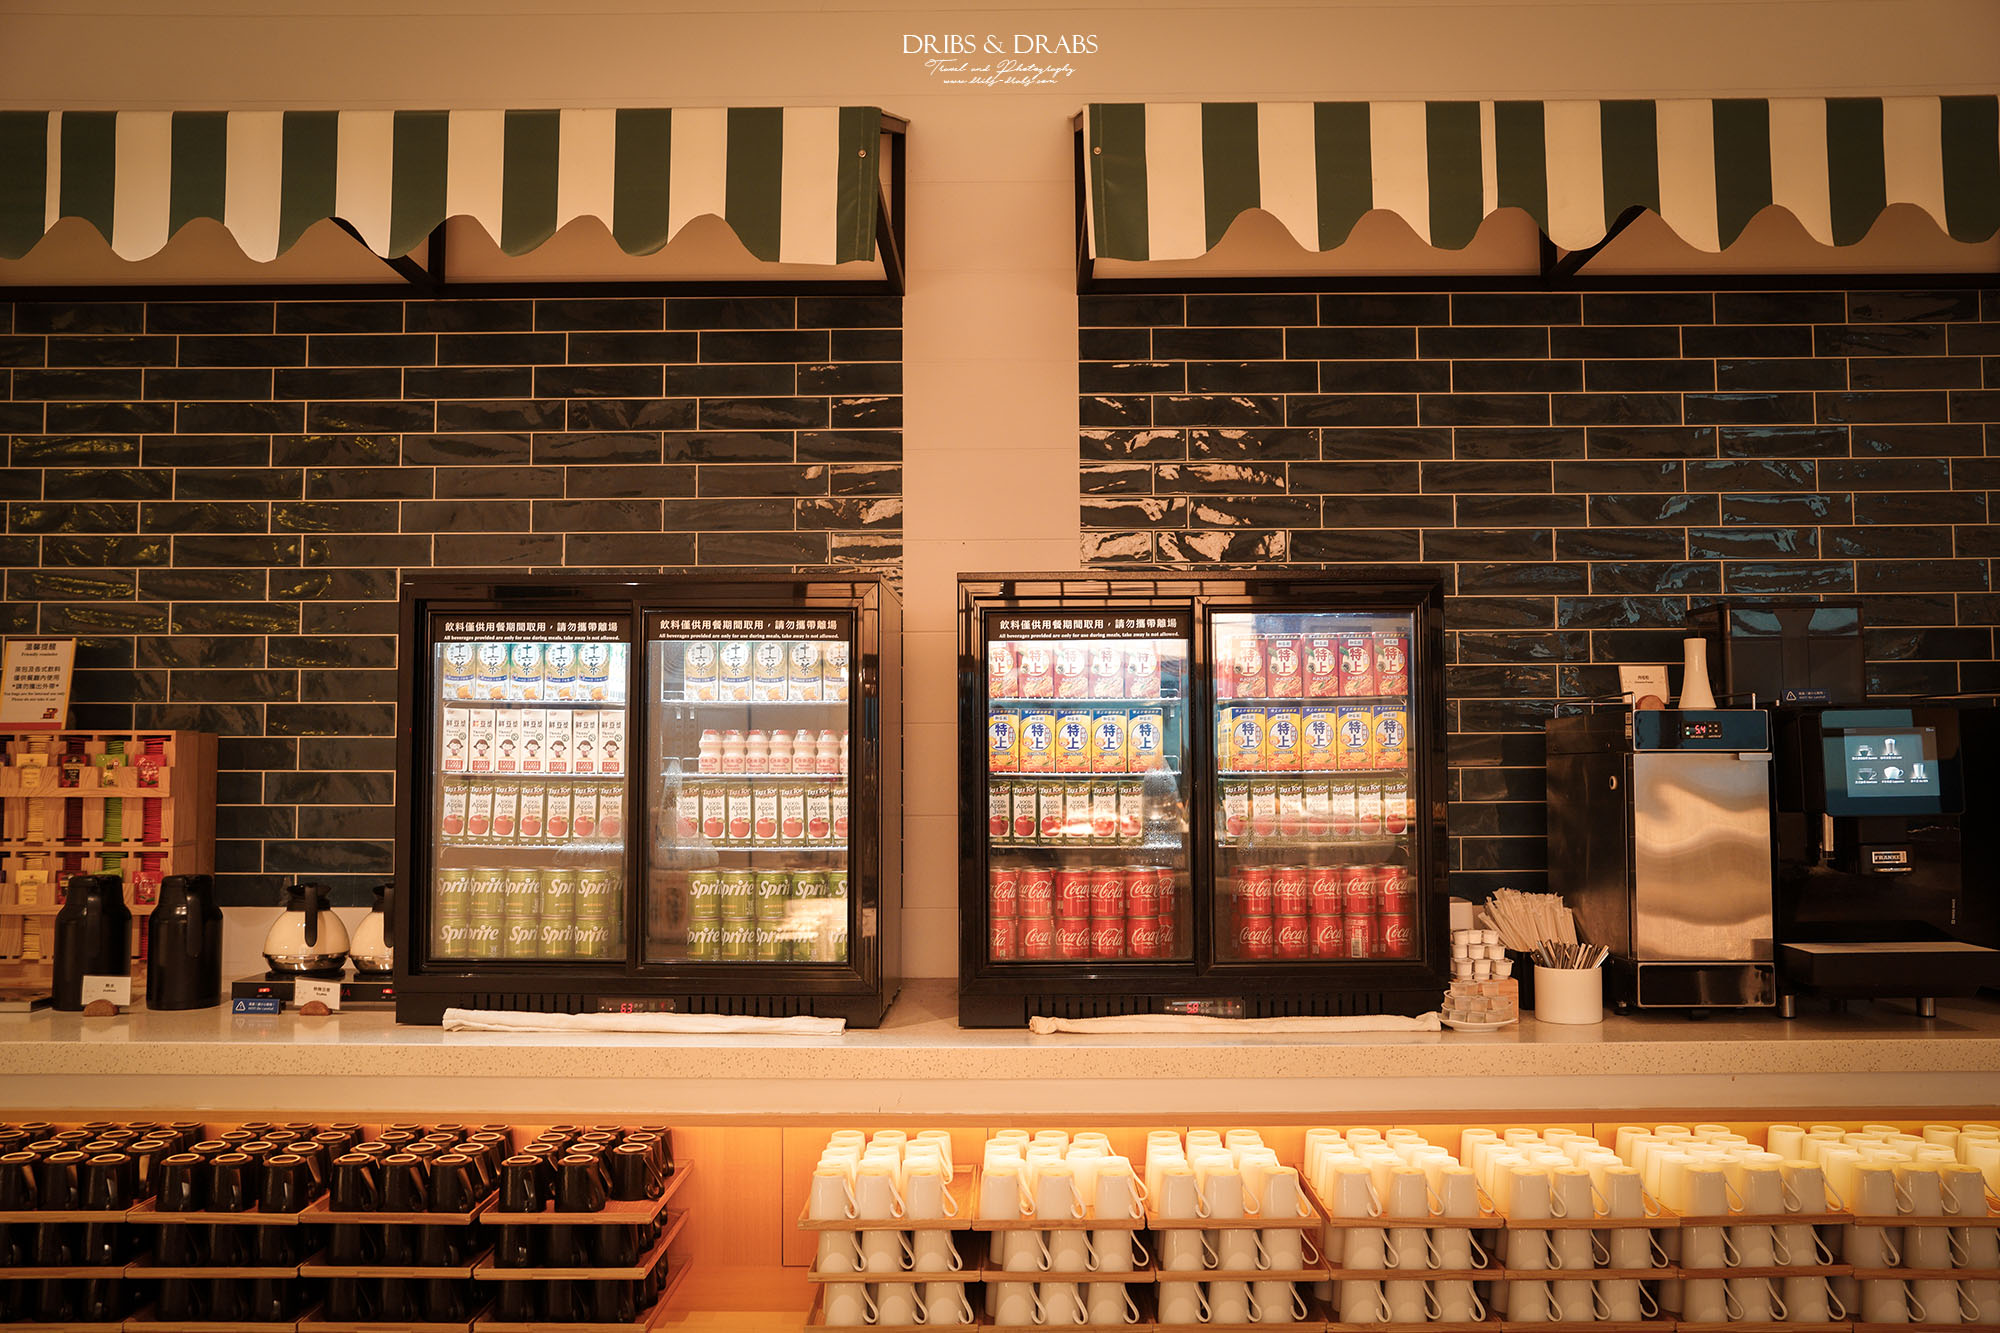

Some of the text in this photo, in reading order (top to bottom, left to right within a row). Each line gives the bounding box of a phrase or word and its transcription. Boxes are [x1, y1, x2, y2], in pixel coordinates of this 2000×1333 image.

[1278, 649, 1291, 674] 特上
[1315, 648, 1328, 673] 特上
[1350, 648, 1363, 673] 特上
[1384, 648, 1397, 672] 特上
[995, 724, 1008, 749] 特上
[1032, 724, 1044, 749] 特上
[1068, 724, 1080, 749] 特上
[1104, 724, 1116, 749] 特上
[1140, 724, 1152, 749] 特上
[1242, 723, 1255, 748] 特上
[1278, 723, 1290, 748] 特上
[1314, 722, 1326, 747] 特上
[1349, 722, 1361, 747] 特上
[1384, 721, 1396, 747] 特上
